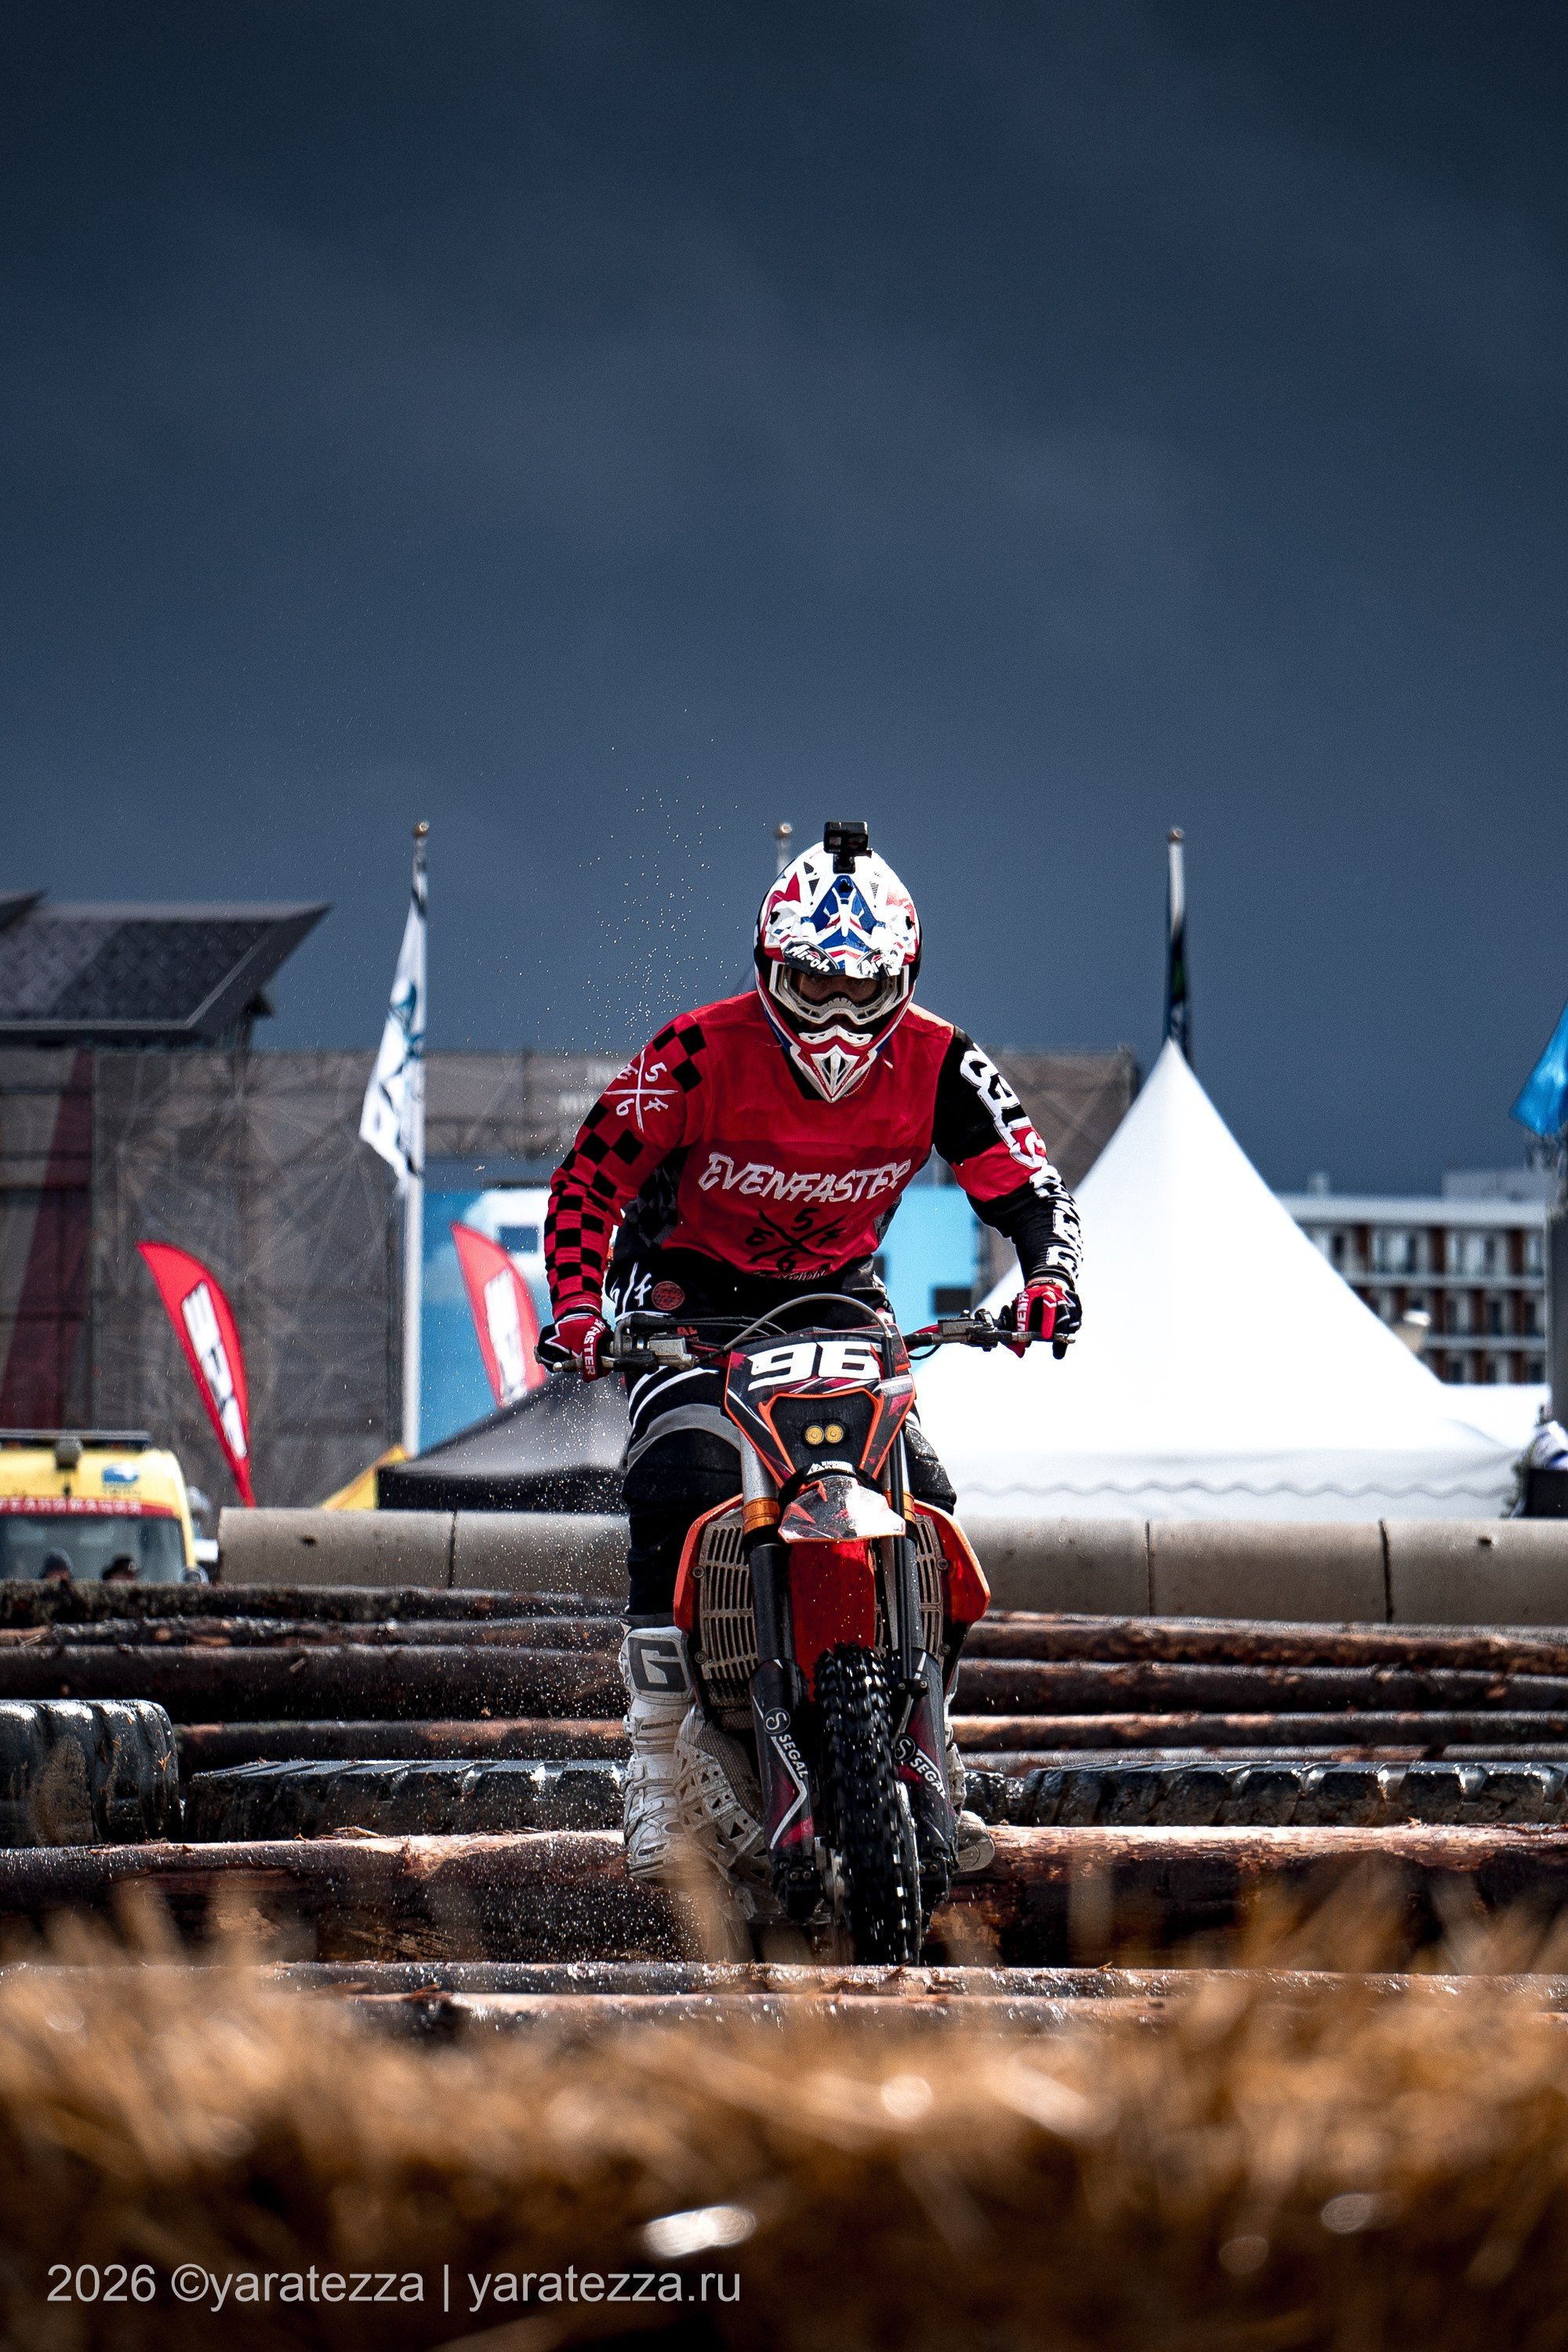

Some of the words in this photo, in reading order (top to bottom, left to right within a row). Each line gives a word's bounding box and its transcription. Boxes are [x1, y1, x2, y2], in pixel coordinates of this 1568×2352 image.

[785, 944, 830, 972] Airoh
[747, 1341, 881, 1392] 96
[779, 1733, 808, 1778] SEGAL
